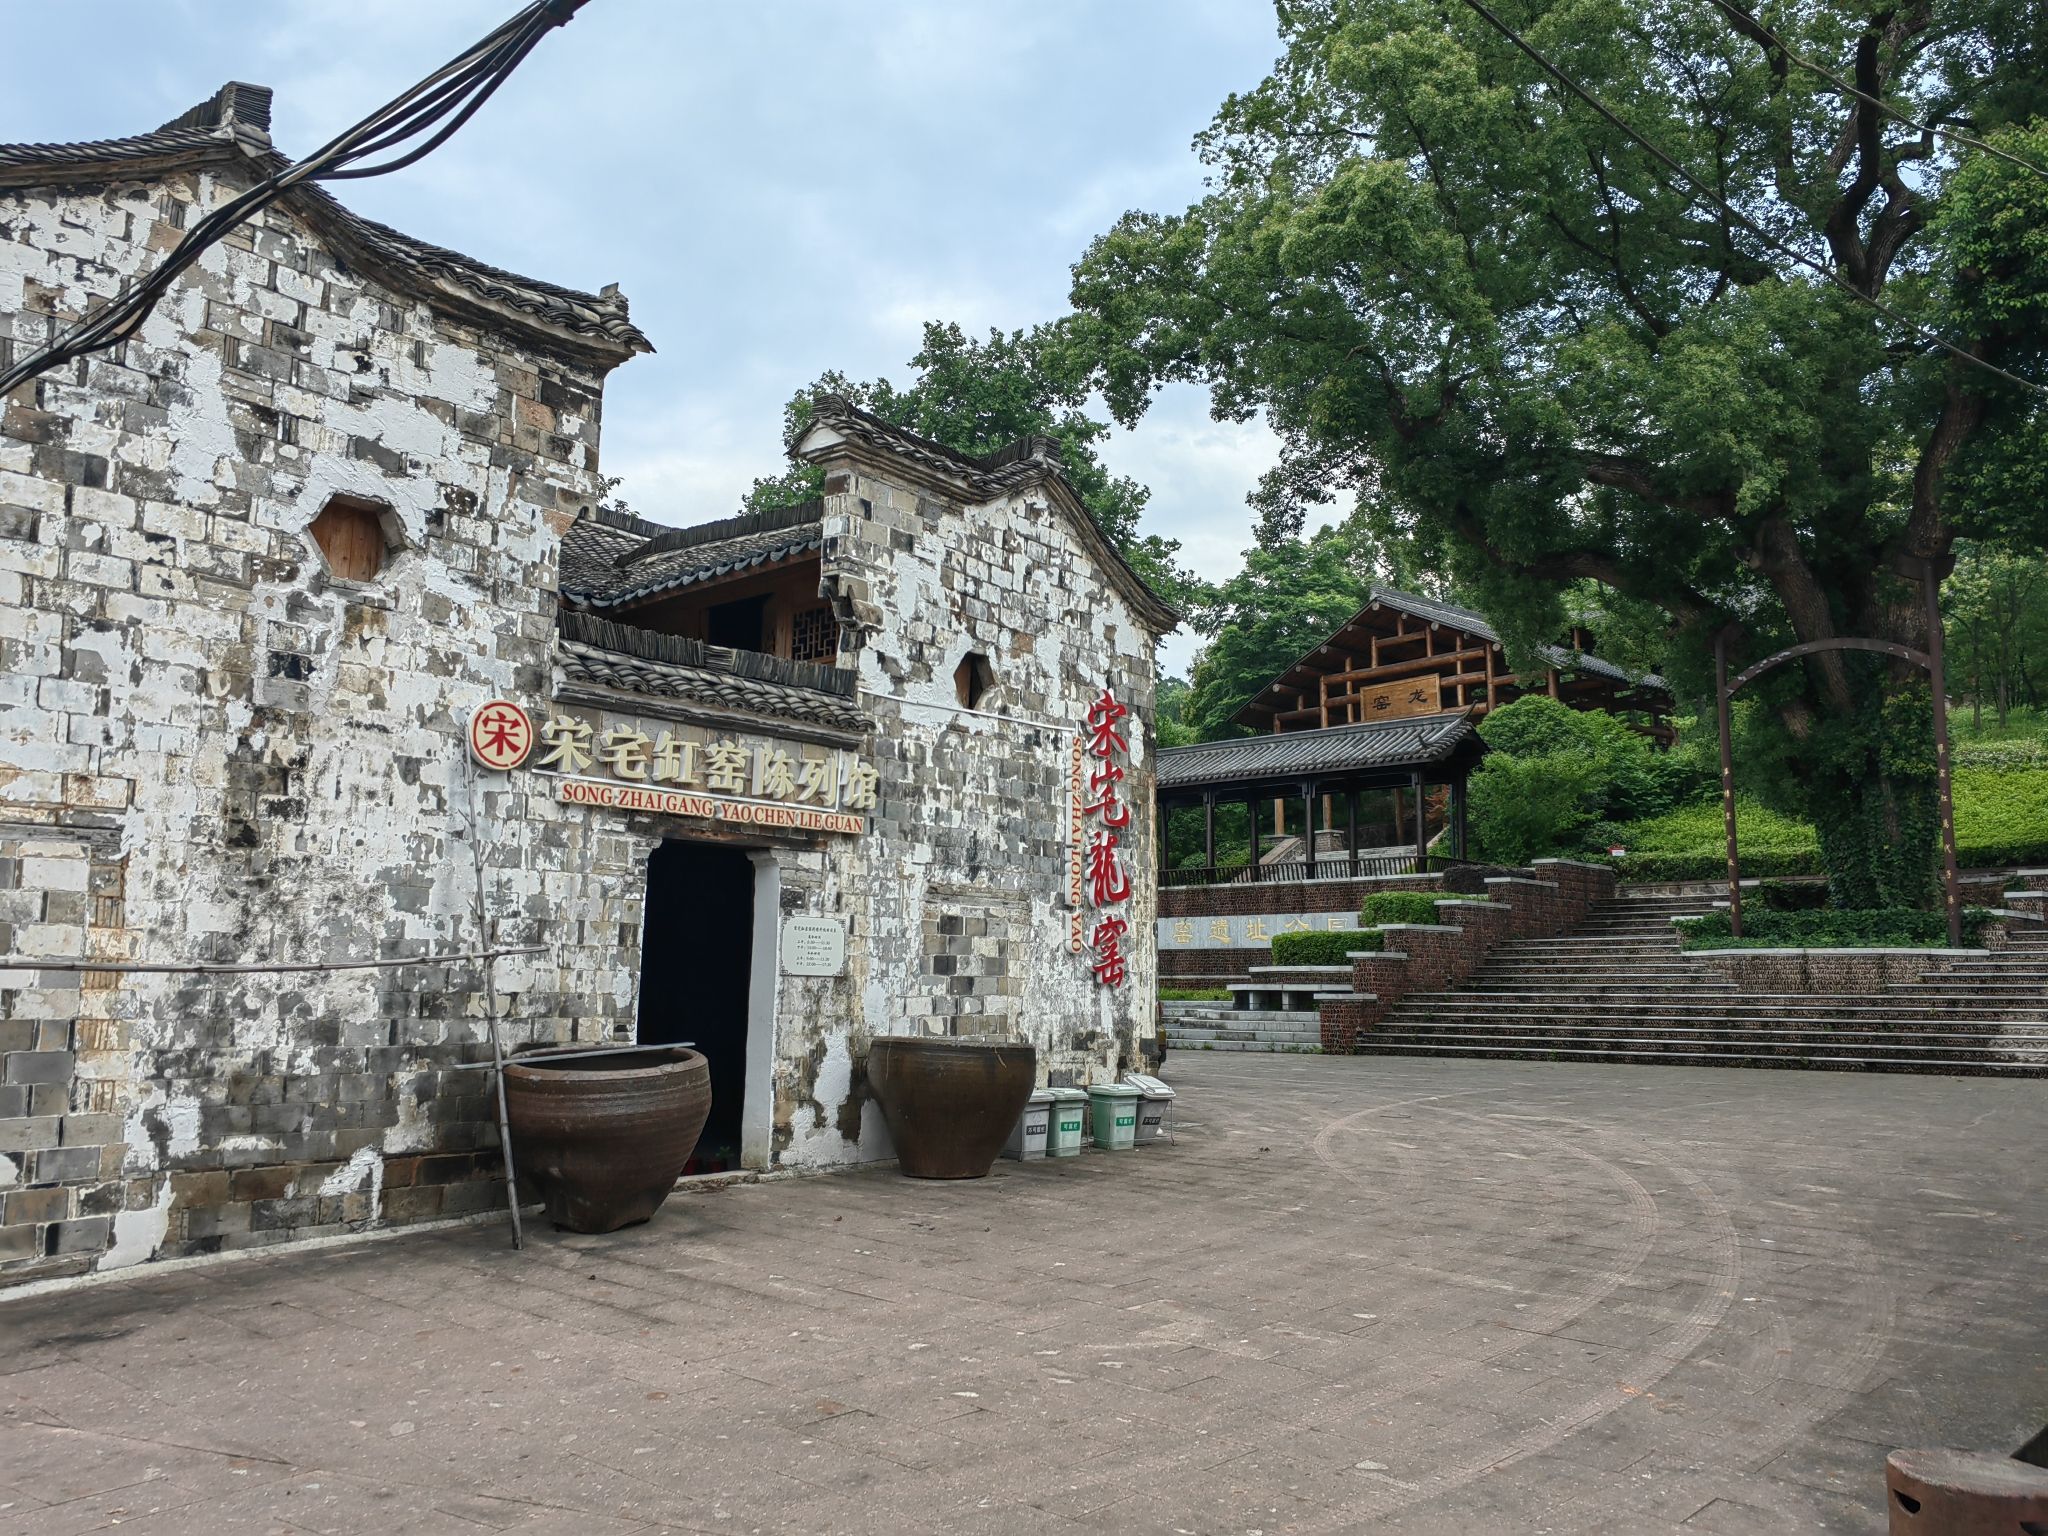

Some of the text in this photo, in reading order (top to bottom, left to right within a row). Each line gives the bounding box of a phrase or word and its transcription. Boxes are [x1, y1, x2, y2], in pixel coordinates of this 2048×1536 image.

[480, 711, 521, 757] 宋
[538, 715, 880, 810] 宋宅缸窑陈列馆
[562, 783, 864, 833] SONG ZHAI GANG YAO CHEN LIE GUAN
[1071, 736, 1081, 952] SONG ZHAI LONG YAO
